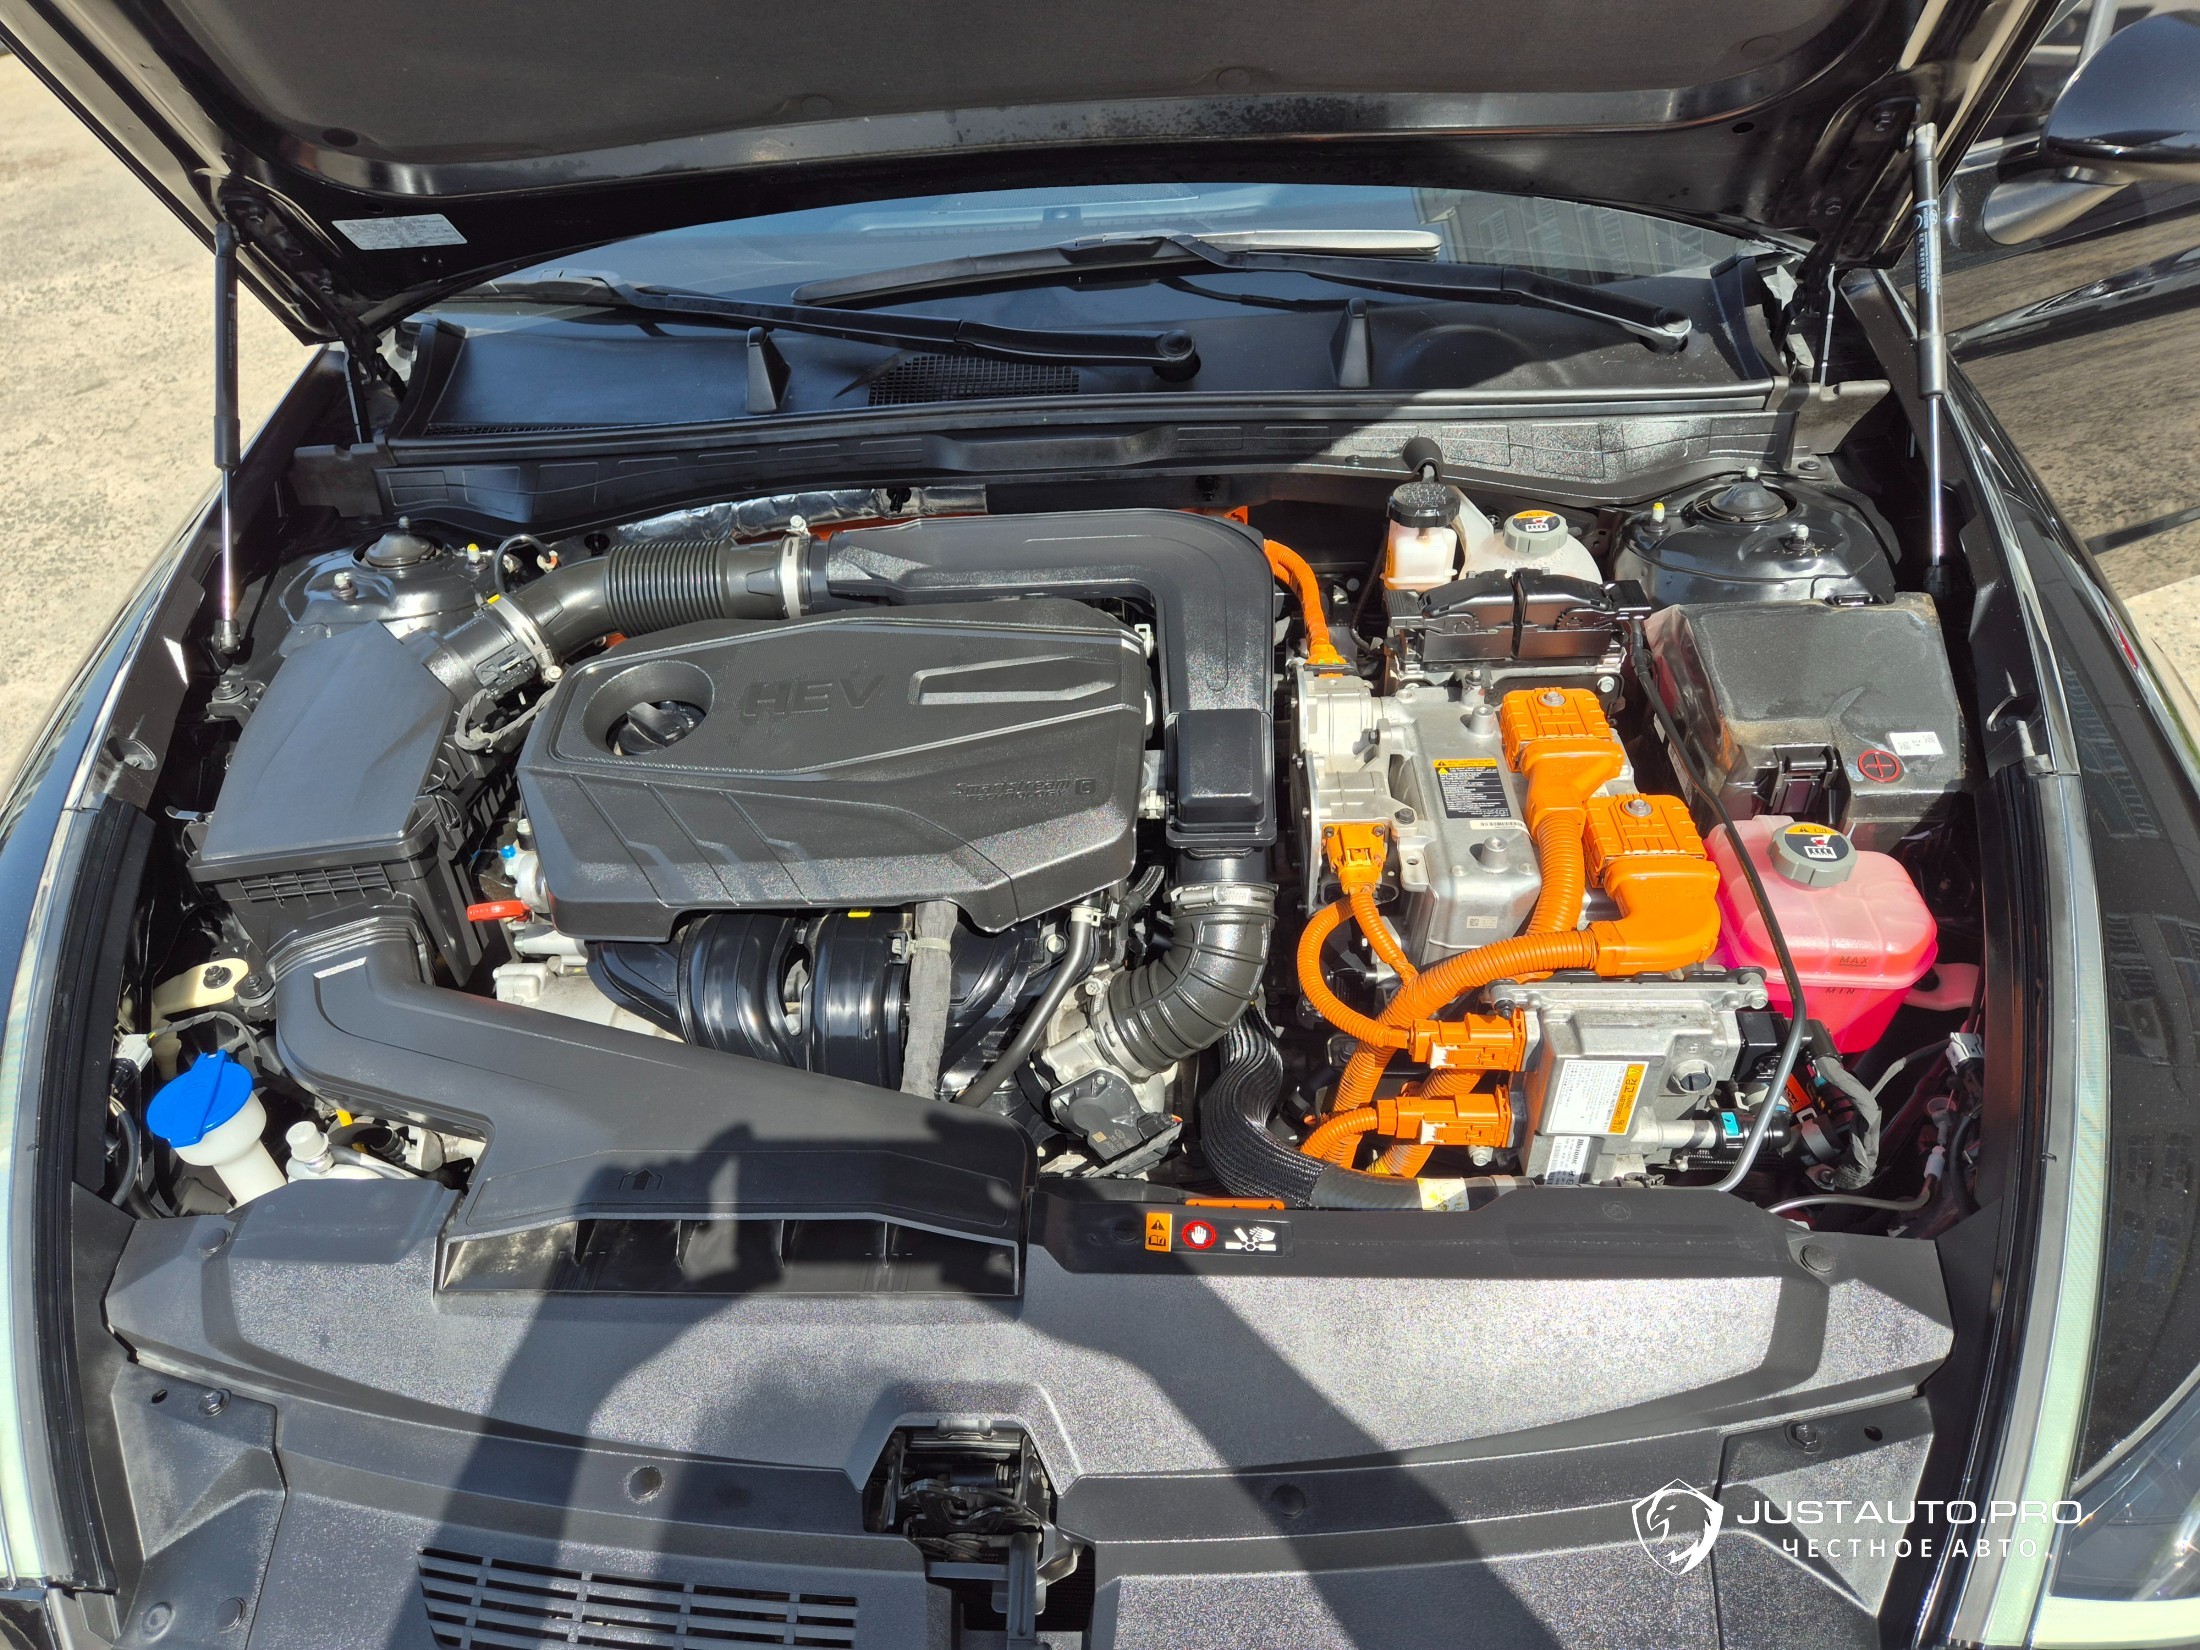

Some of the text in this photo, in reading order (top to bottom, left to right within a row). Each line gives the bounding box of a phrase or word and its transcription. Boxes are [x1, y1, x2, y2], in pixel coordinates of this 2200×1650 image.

[740, 673, 886, 717] HEV
[951, 778, 1070, 795] Smartstream
[1839, 956, 1869, 965] MAX
[1825, 987, 1856, 995] MIN
